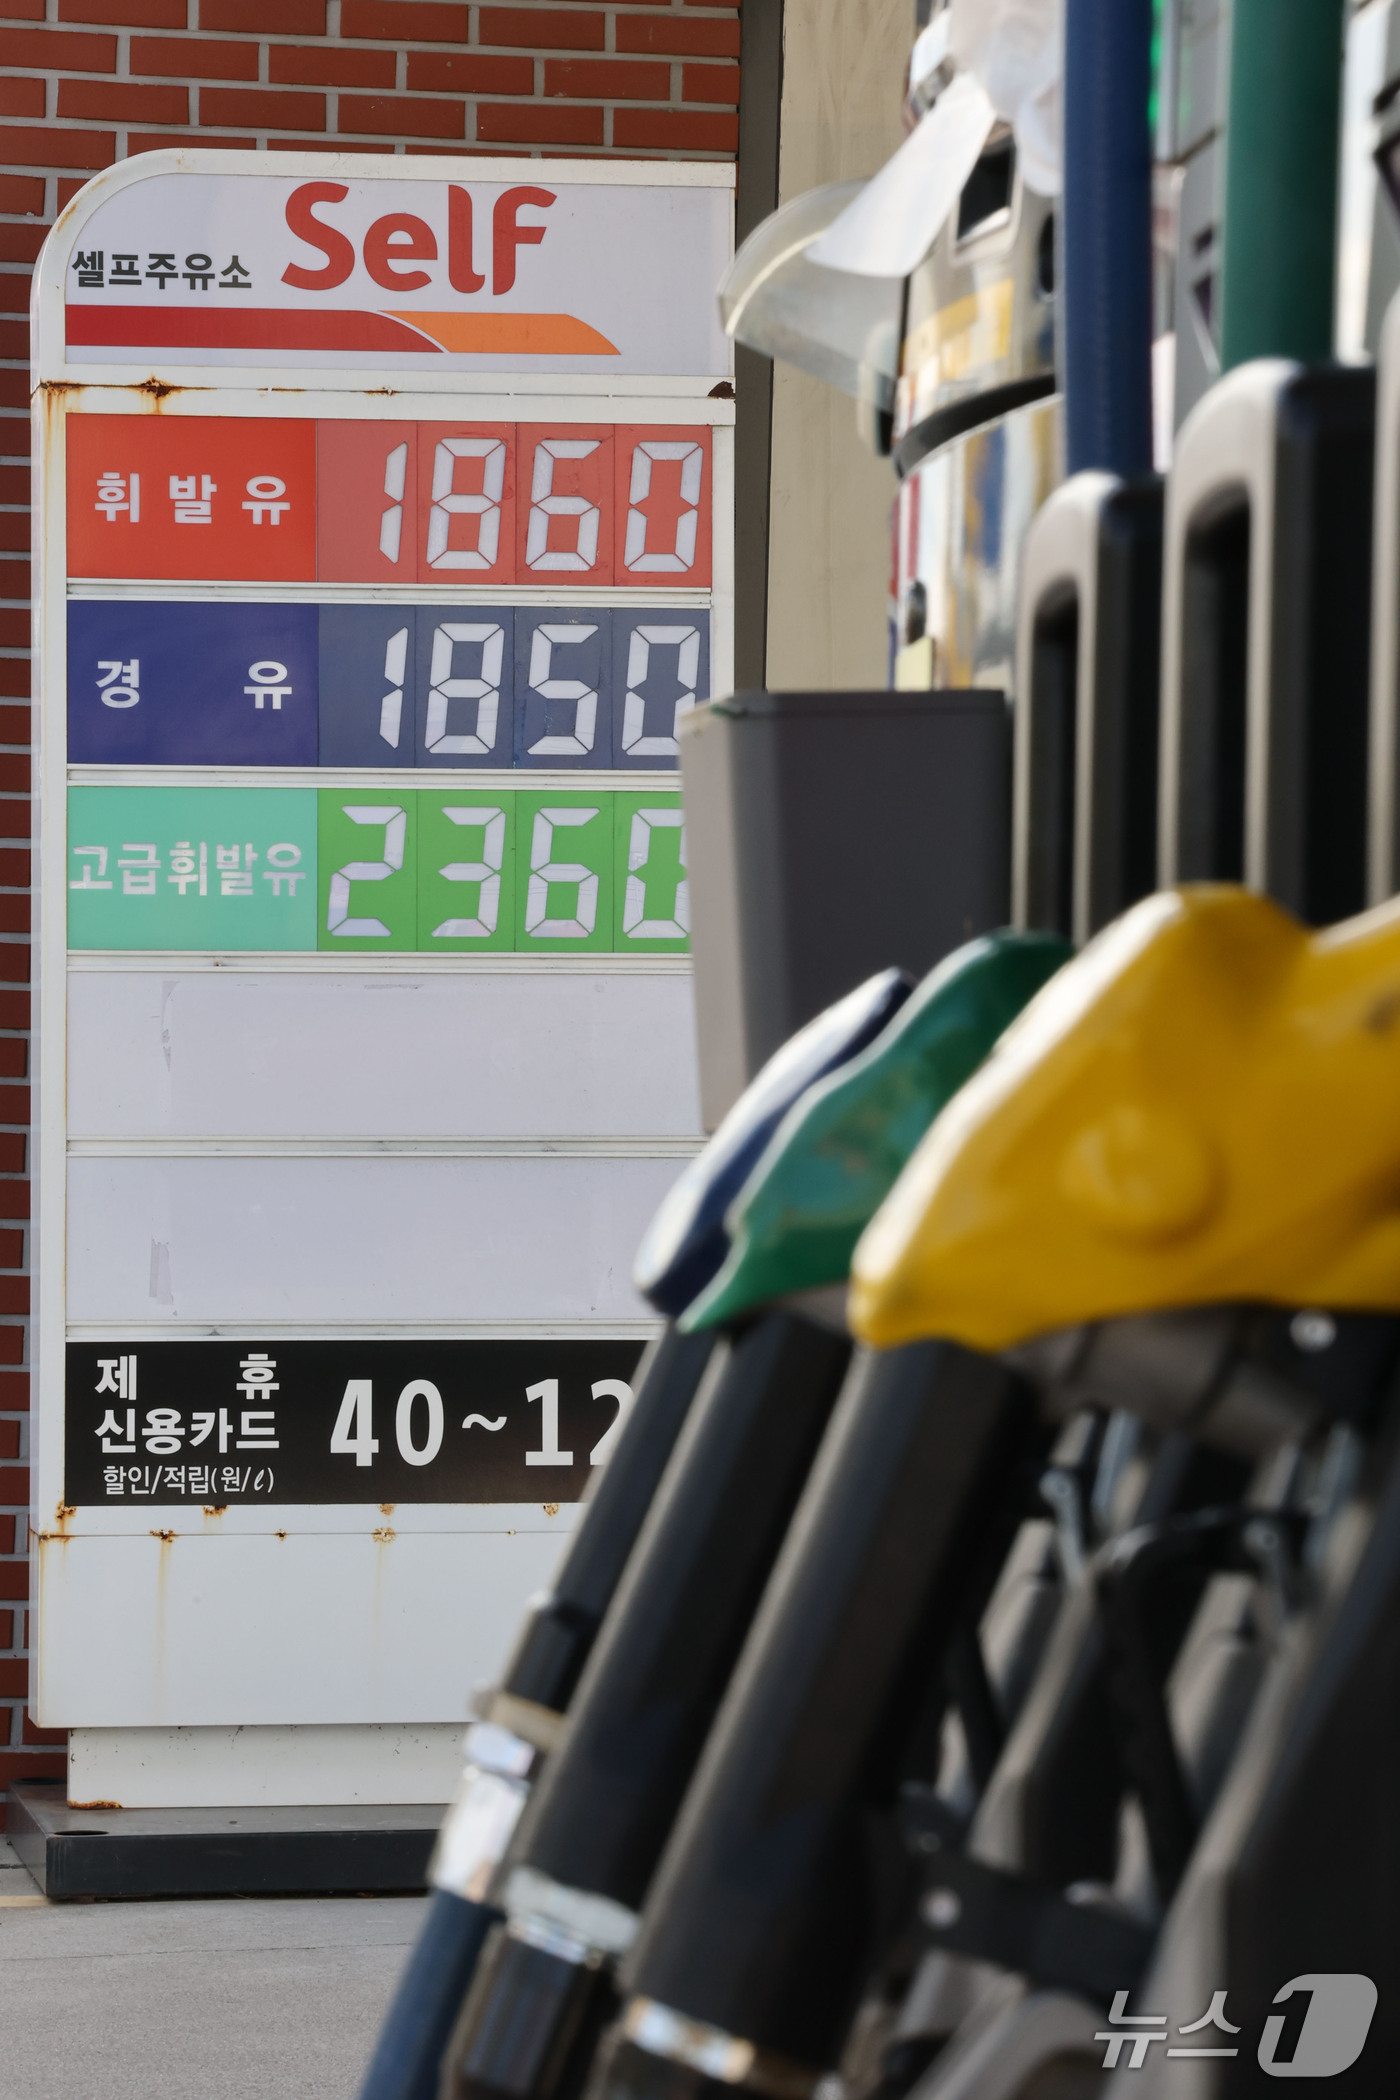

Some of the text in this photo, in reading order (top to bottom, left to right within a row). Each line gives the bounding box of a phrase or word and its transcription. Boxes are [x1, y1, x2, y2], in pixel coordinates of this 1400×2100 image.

[71, 250, 253, 291] 셀프주유소
[280, 181, 558, 296] Self
[94, 437, 704, 574] 휘발유 1860
[379, 622, 701, 756] 1850
[69, 805, 690, 939] 고급휘발유 2360
[94, 1407, 280, 1455] 신용카드
